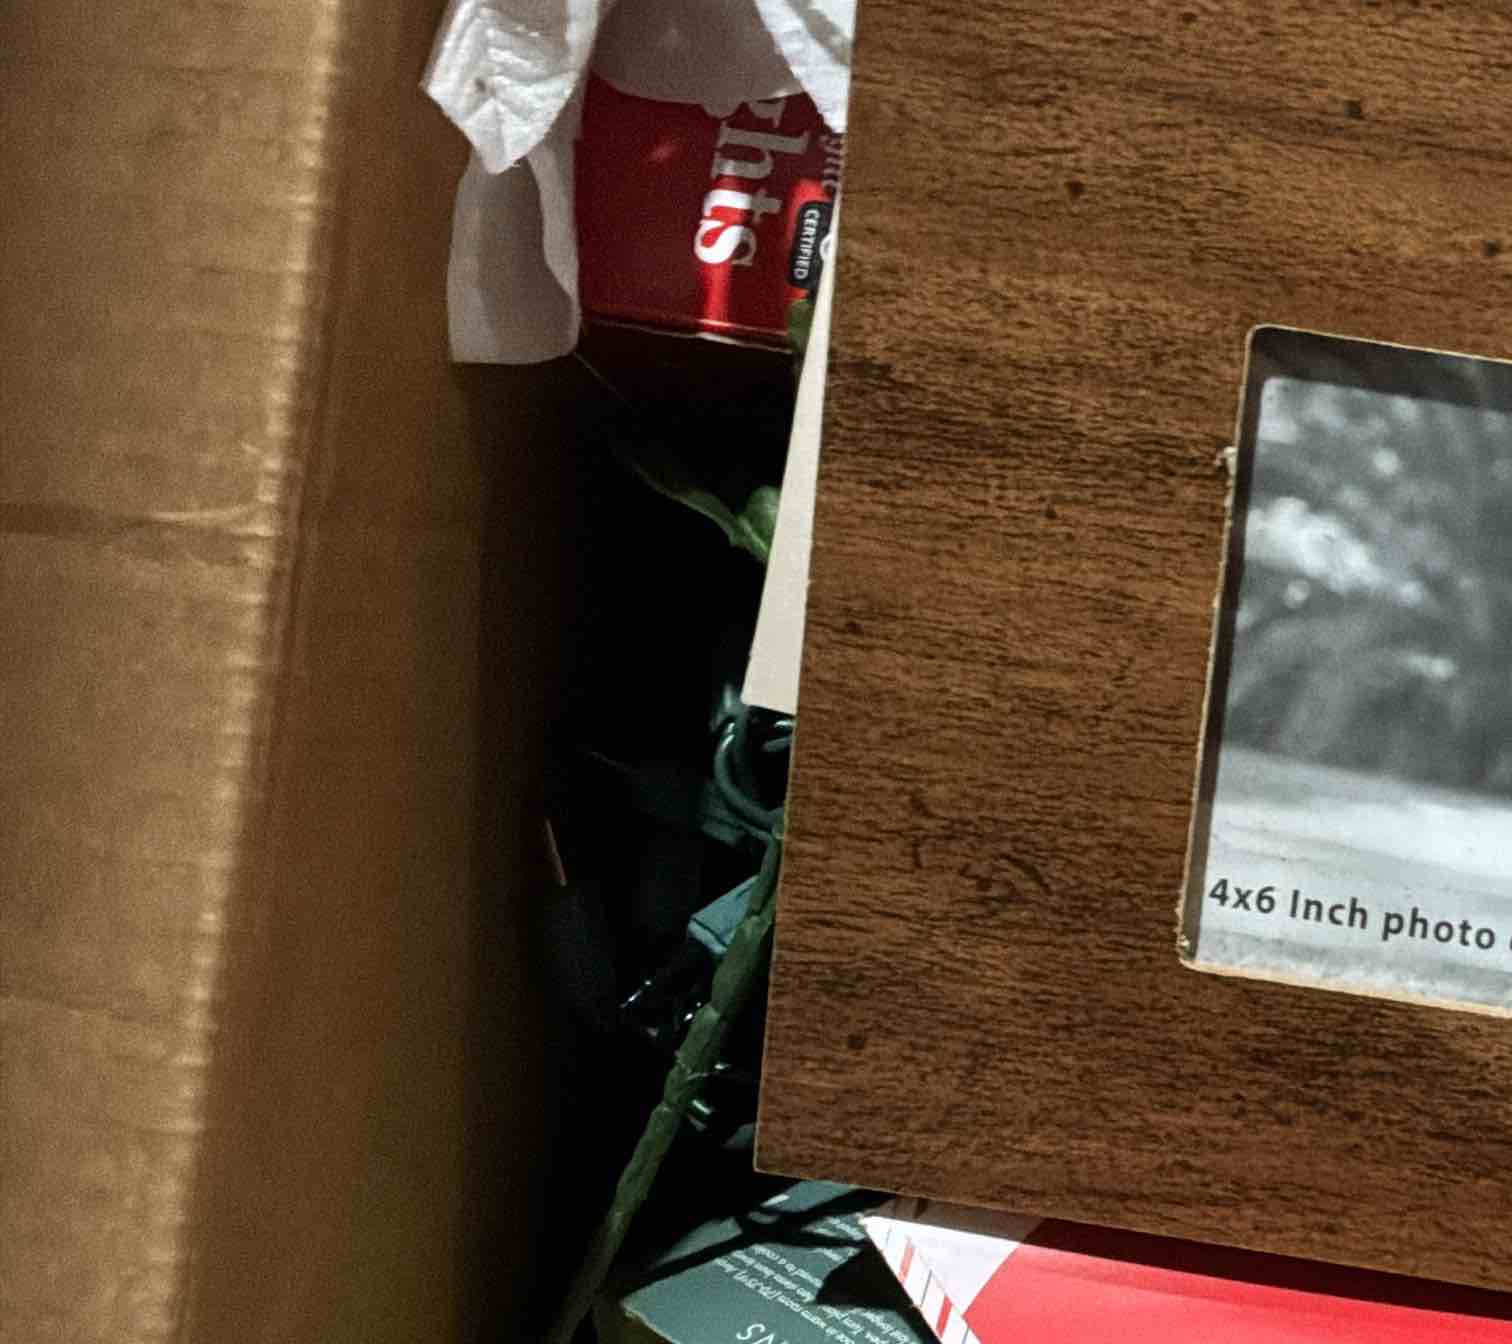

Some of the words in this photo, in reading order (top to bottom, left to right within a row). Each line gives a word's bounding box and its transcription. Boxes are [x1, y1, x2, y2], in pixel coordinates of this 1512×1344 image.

[793, 208, 820, 279] CERTIFIED
[1207, 876, 1277, 915] 4x6
[1289, 889, 1370, 930] Inch
[1381, 903, 1497, 954] photo
